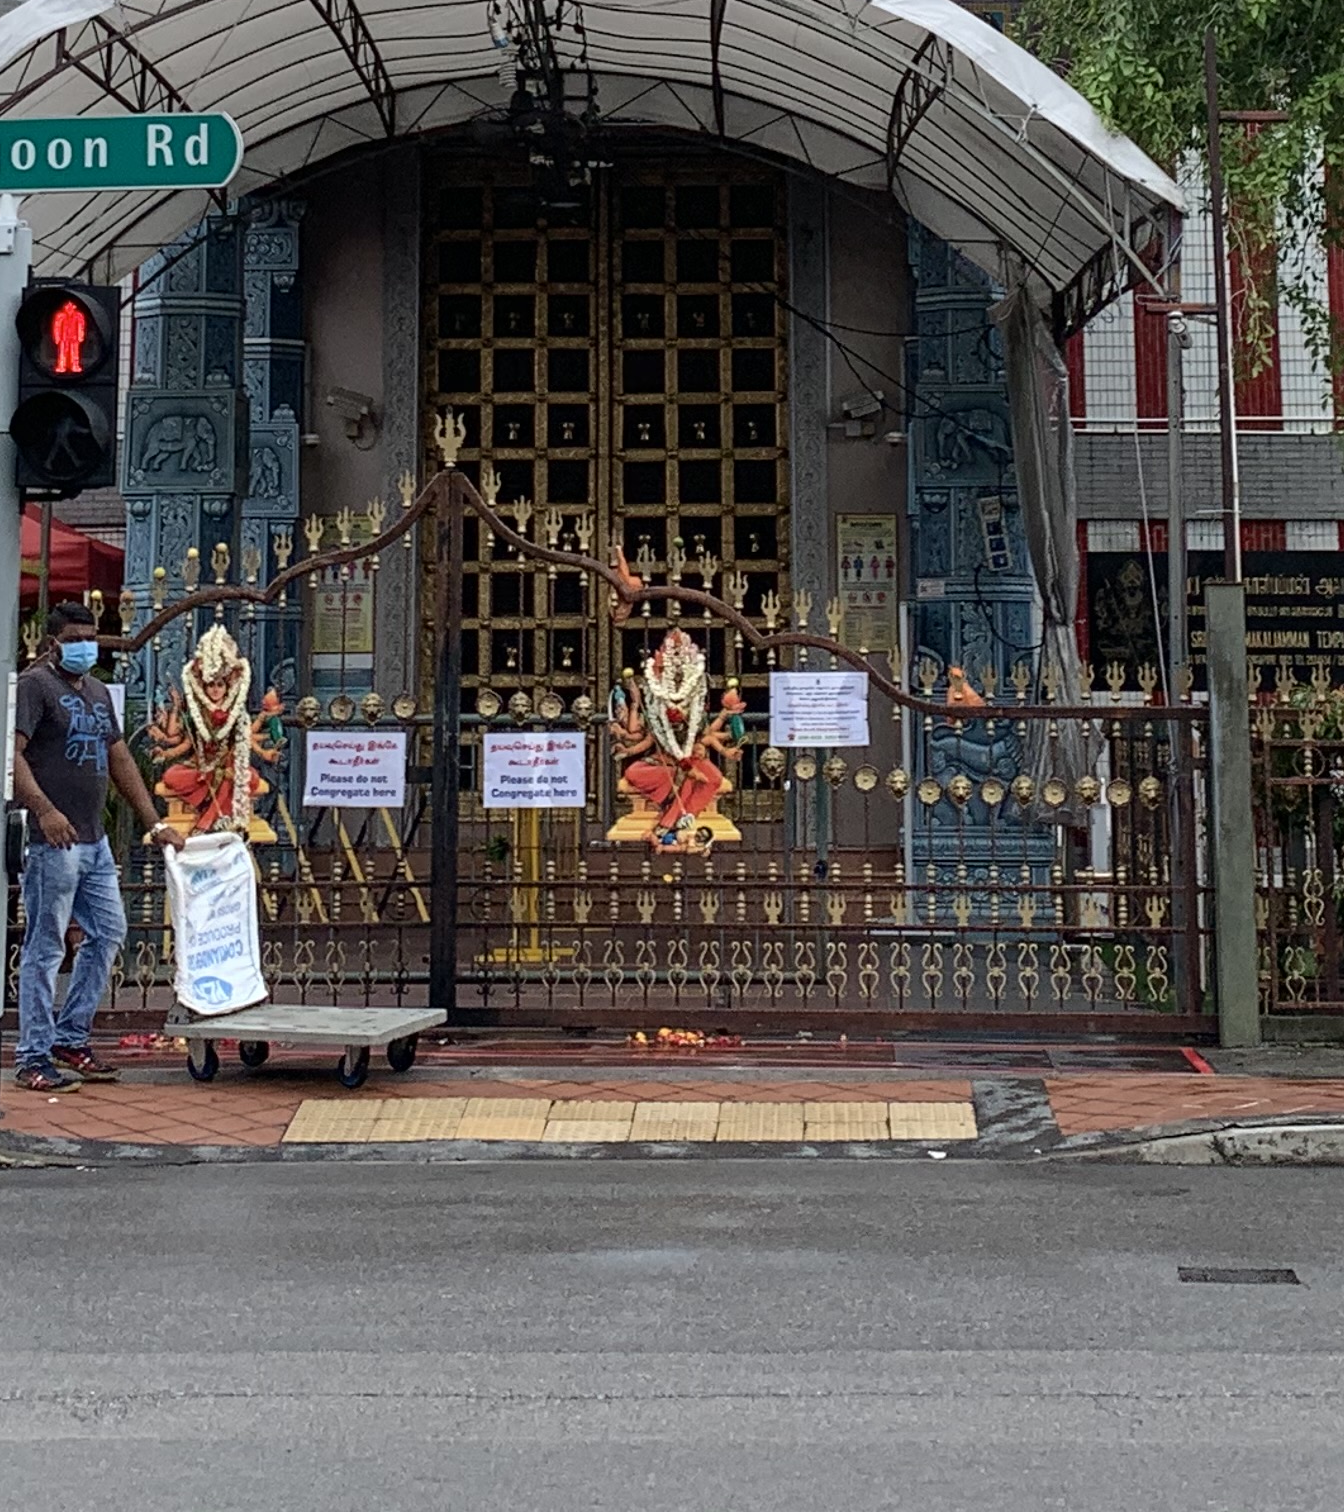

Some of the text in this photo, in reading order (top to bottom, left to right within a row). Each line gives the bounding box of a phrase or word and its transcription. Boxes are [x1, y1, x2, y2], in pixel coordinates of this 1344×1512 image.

[146, 123, 209, 167] Rd
[320, 773, 388, 784] Please do not
[500, 775, 568, 784] Please do not
[311, 786, 397, 798] Congregate here
[491, 788, 578, 799] Congregate here
